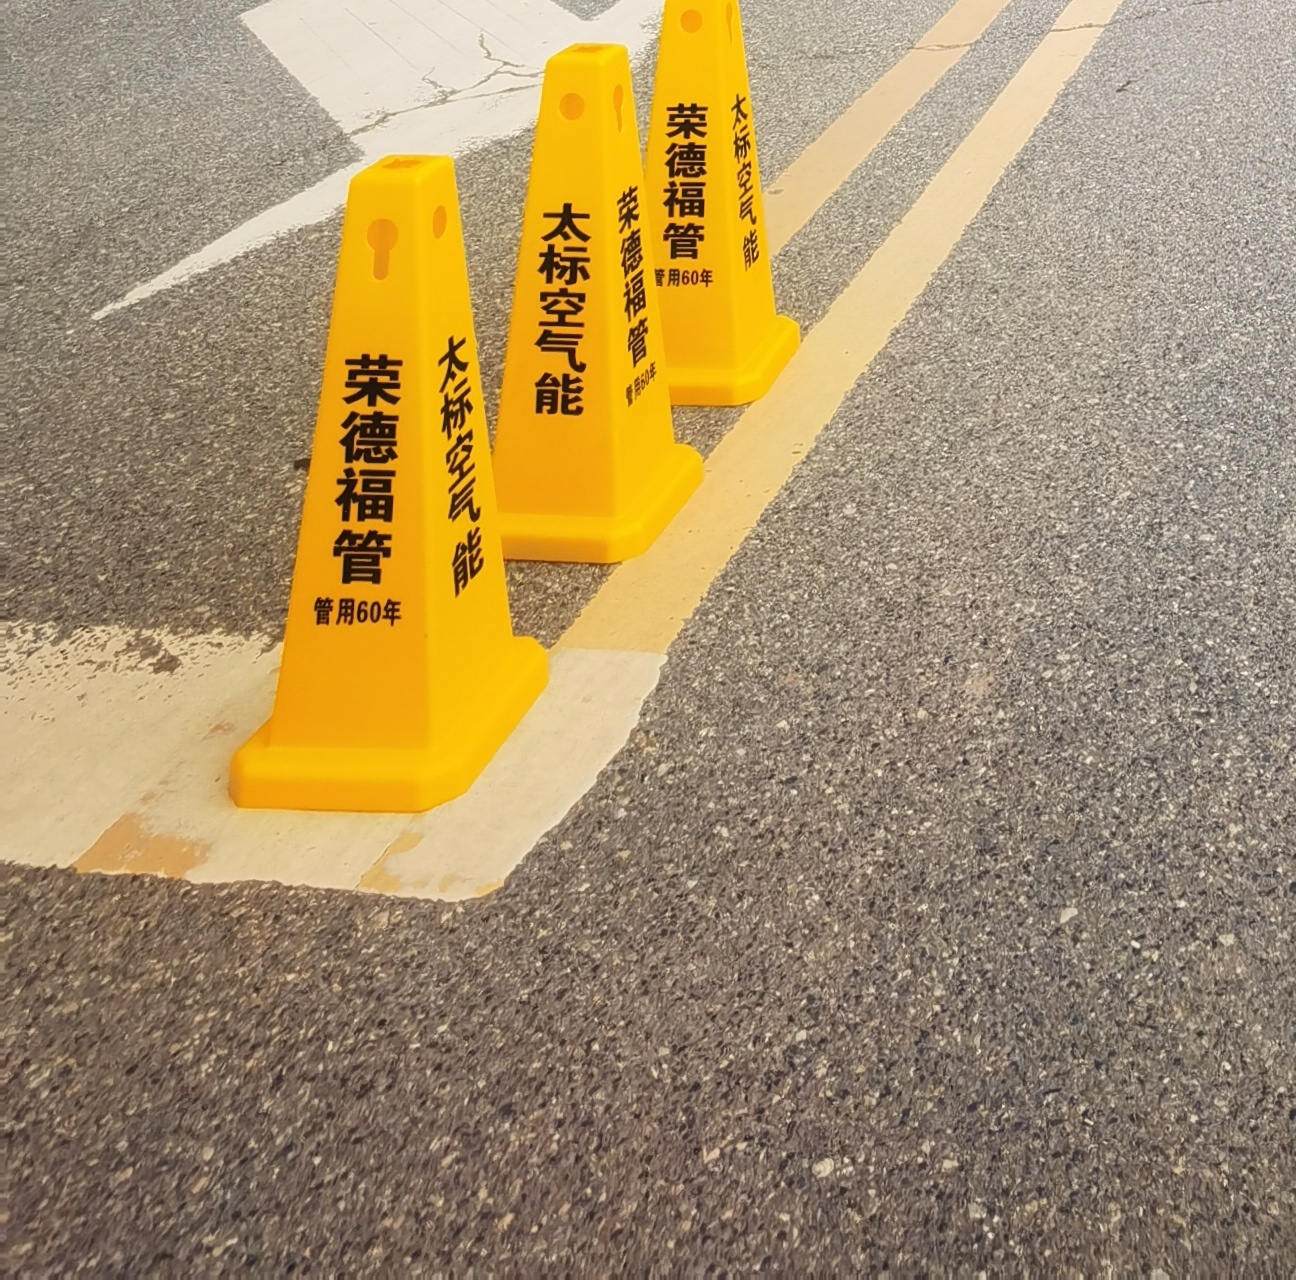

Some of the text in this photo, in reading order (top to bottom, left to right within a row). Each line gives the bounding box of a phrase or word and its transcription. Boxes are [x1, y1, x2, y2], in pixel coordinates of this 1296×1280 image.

[663, 102, 709, 260] 荣德福管
[730, 93, 760, 273] 太标空气能
[534, 202, 592, 417] 太标空气能
[616, 185, 649, 369] 荣德福管
[333, 353, 404, 585] 荣德福管
[437, 334, 485, 598] 太标空气能
[625, 361, 658, 408] 管用60年
[313, 596, 402, 627] 管用60年
